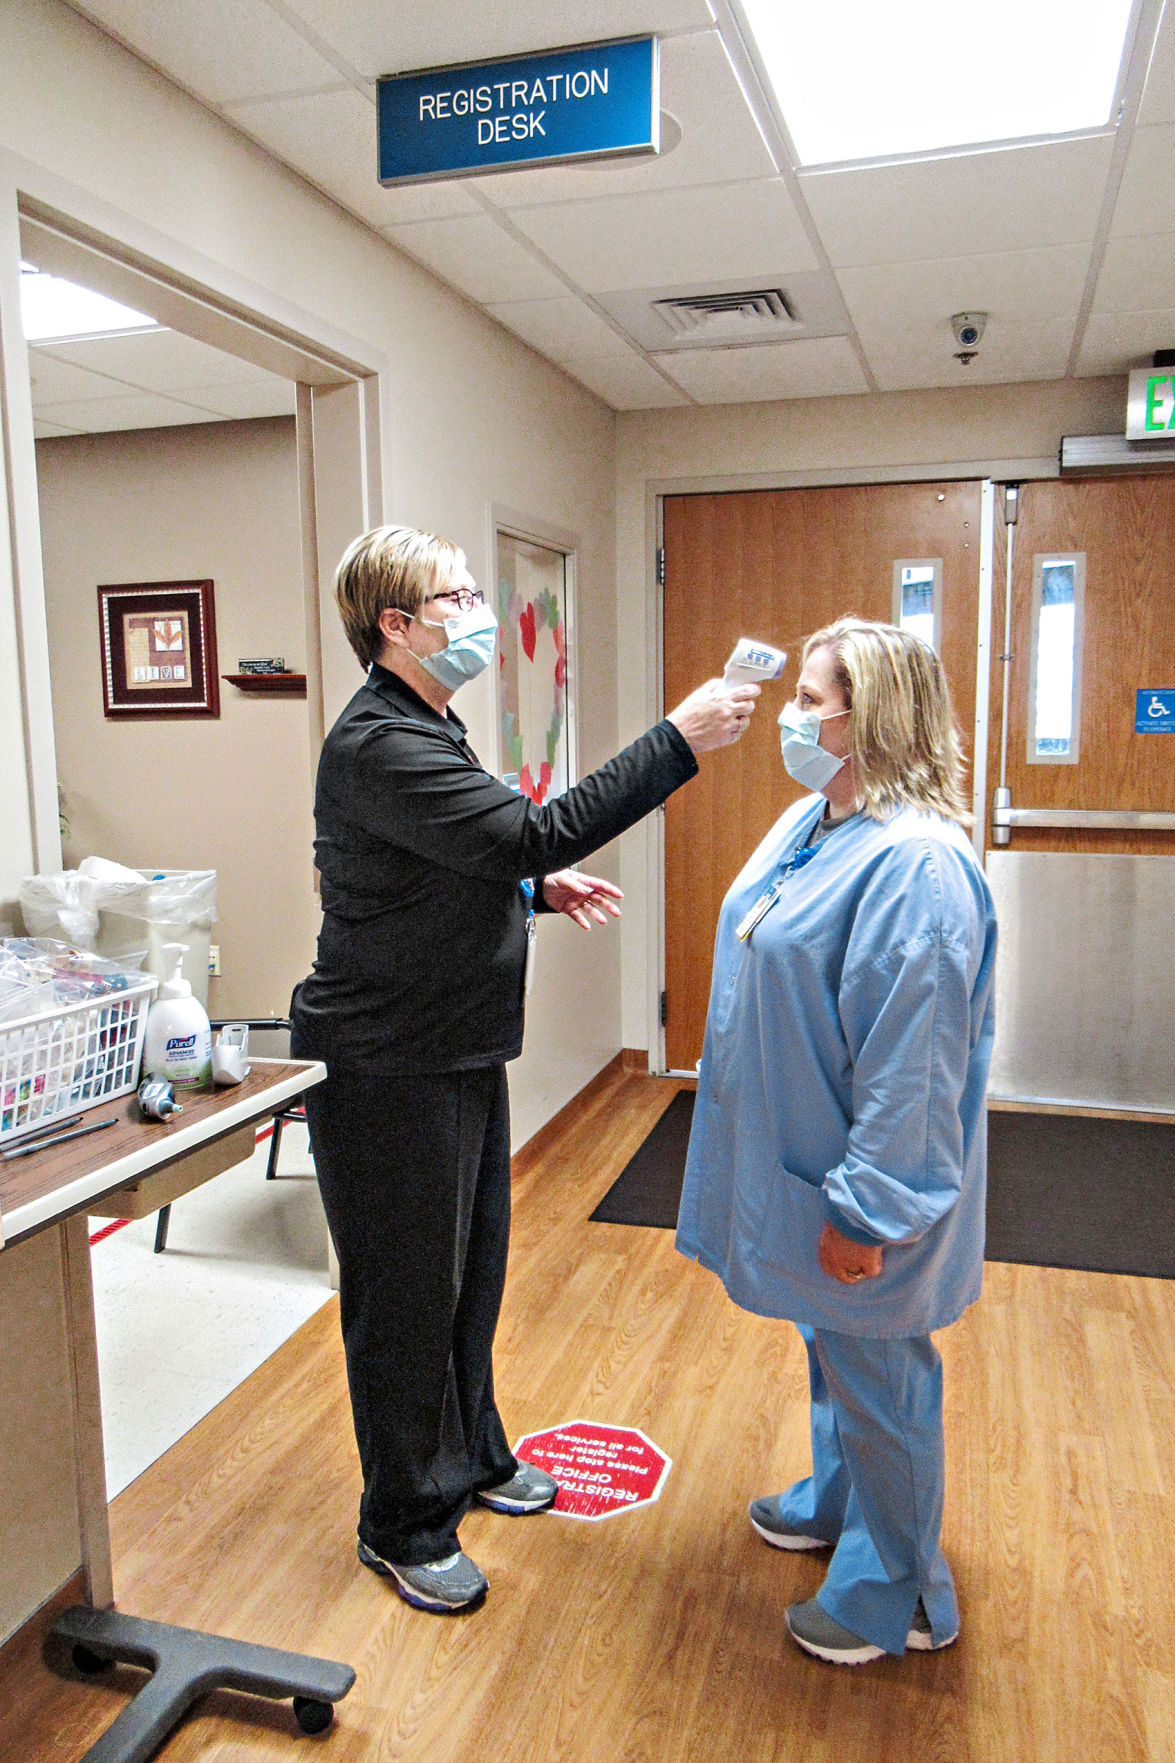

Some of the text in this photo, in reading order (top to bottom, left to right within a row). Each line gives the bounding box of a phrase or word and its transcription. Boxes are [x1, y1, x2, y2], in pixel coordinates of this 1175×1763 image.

[419, 68, 609, 121] REGISTRATION
[477, 110, 547, 145] DESK
[554, 1433, 645, 1455] for all services.
[569, 1446, 618, 1459] register
[531, 1448, 649, 1475] Please stop here to
[551, 1465, 612, 1484] OFFICE
[558, 1479, 639, 1501] REGISTRA
